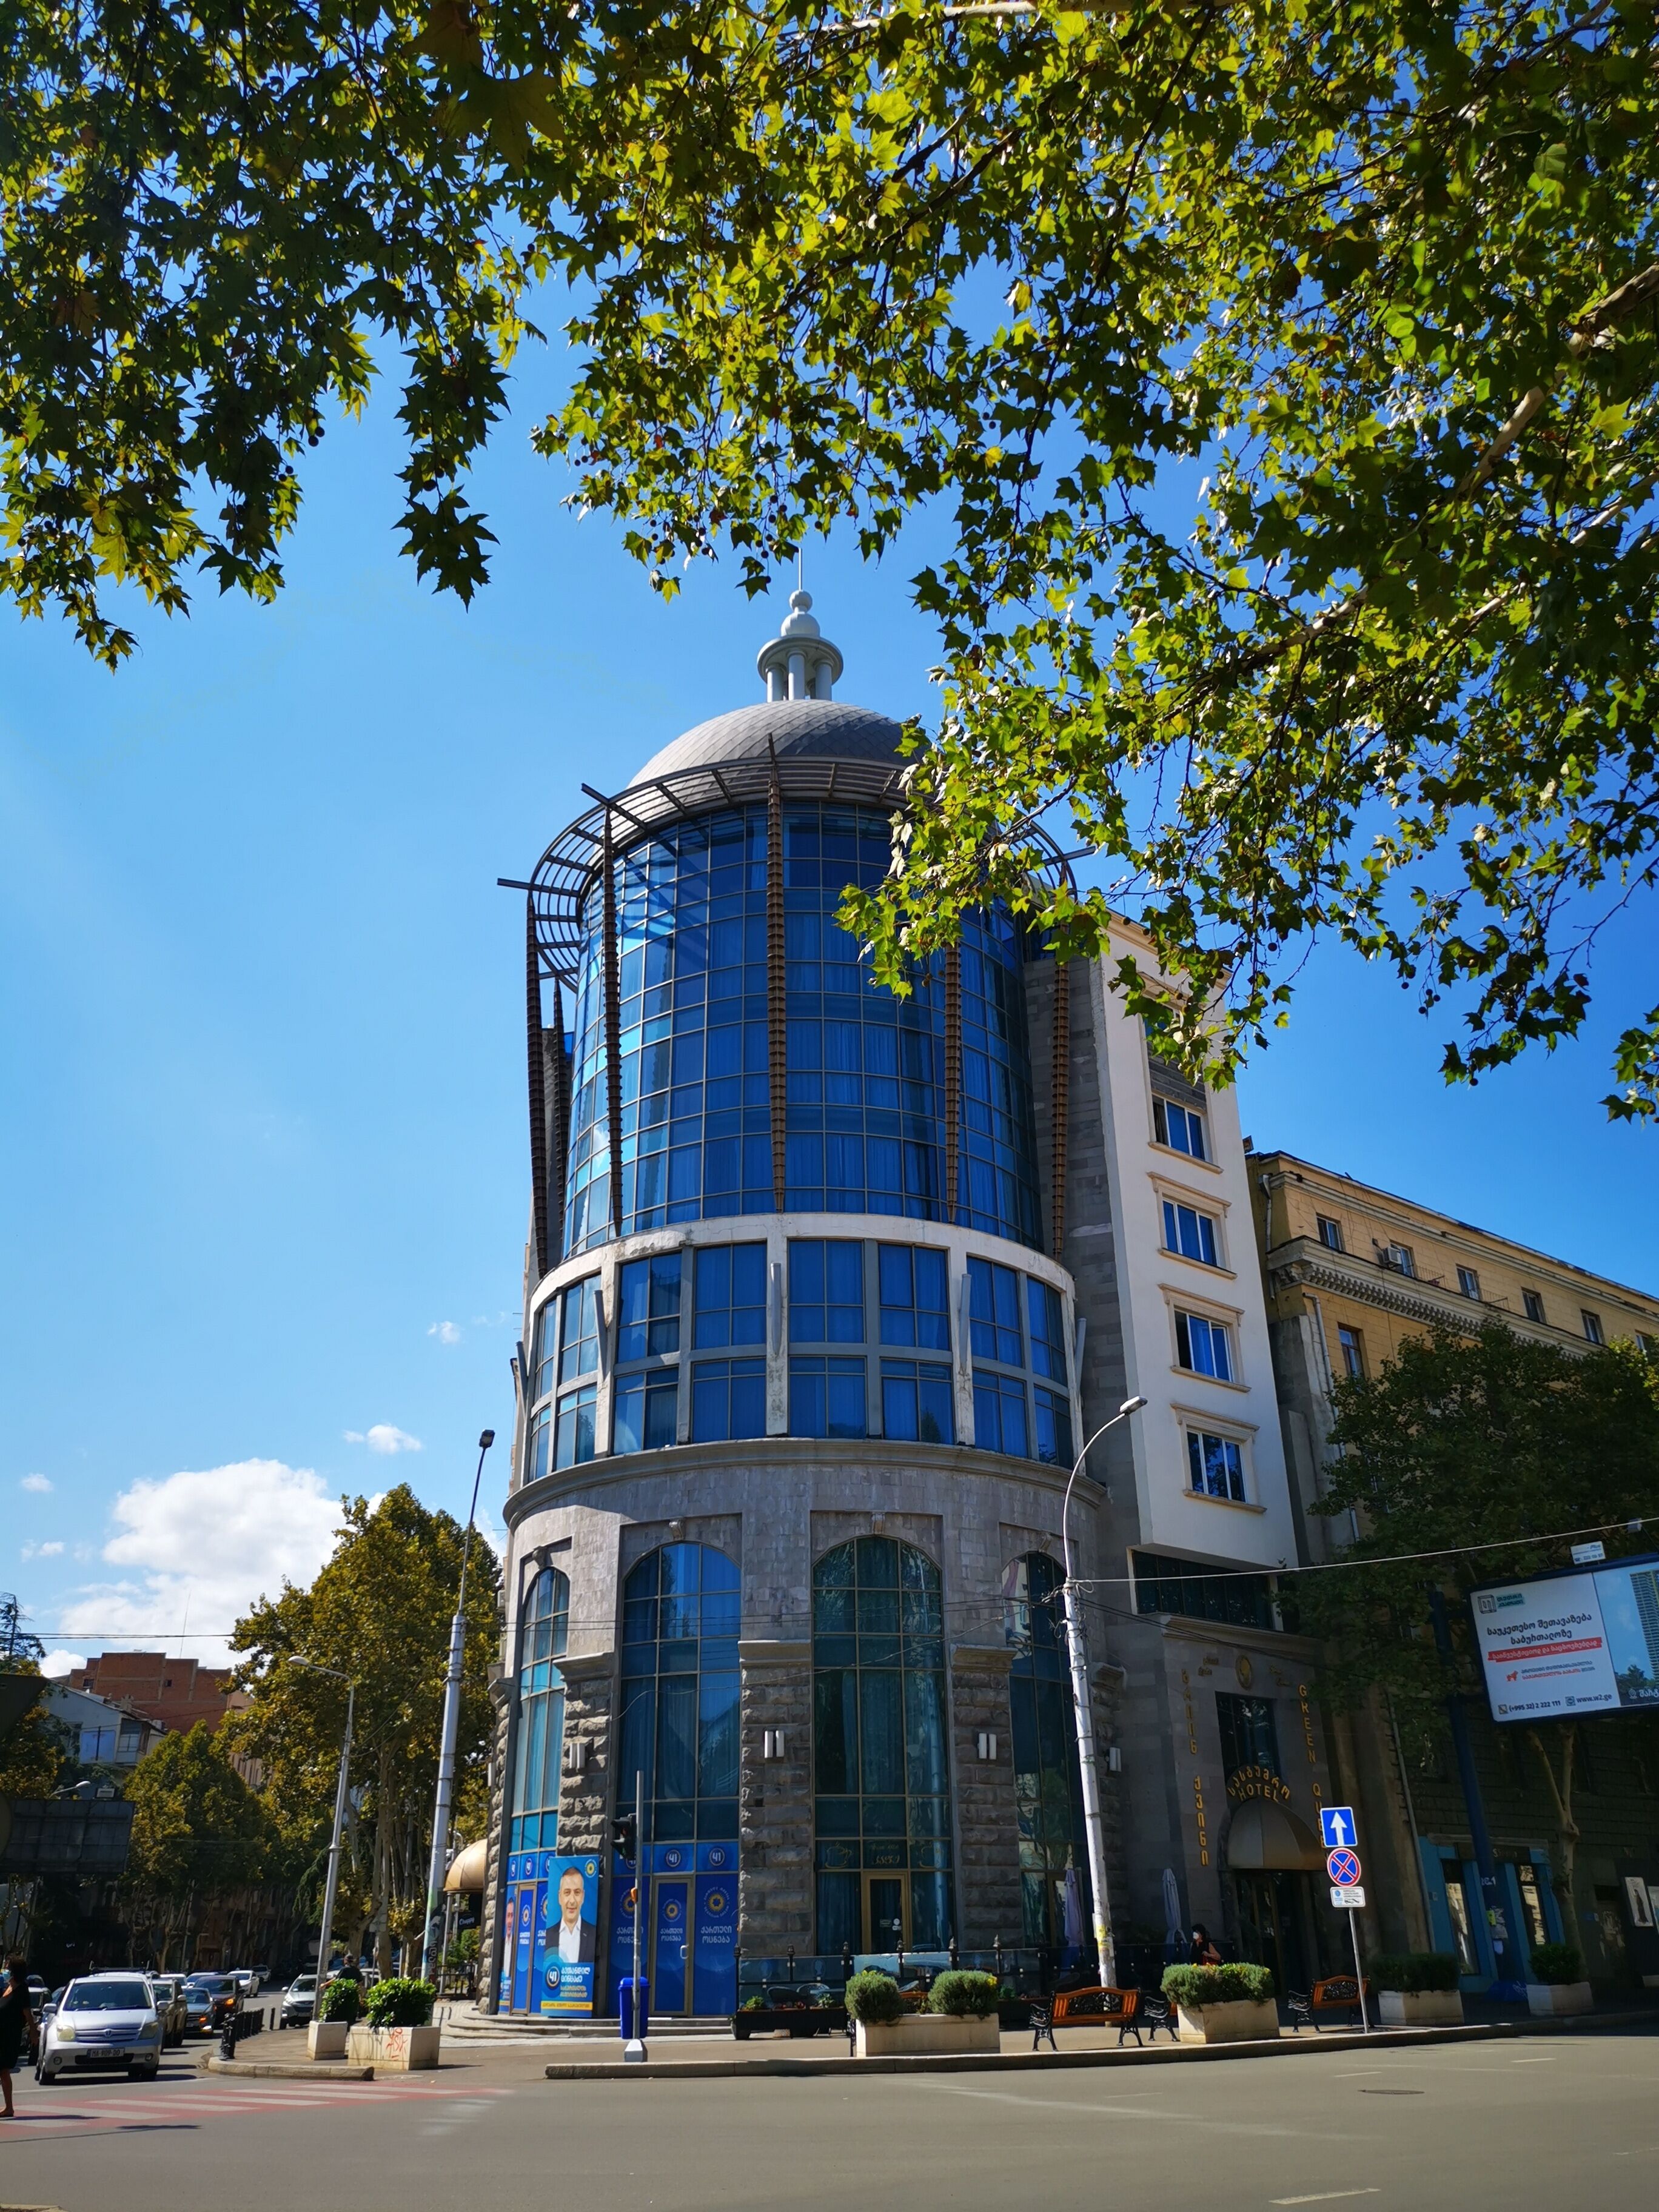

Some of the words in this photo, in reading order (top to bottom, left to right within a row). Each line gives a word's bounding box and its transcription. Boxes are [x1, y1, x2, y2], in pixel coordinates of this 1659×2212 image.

[1487, 1621, 1535, 1636] საუკეთესო
[1538, 1613, 1592, 1629] შეთავაზება
[1510, 1630, 1572, 1644] საბურთალოზე
[1577, 1693, 1612, 1704] www.w2.ge
[1509, 1704, 1526, 1712] (+995
[1526, 1703, 1535, 1711] 32)
[1299, 1684, 1316, 1764] GREEN
[1227, 1765, 1290, 1799] სასტუმრო
[1238, 1783, 1280, 1803] HOTEL
[669, 1853, 677, 1863] 41
[712, 1852, 721, 1862] 41
[700, 1925, 732, 1934] ქართული
[702, 1936, 730, 1944] ოცნება
[549, 1971, 557, 1982] 41
